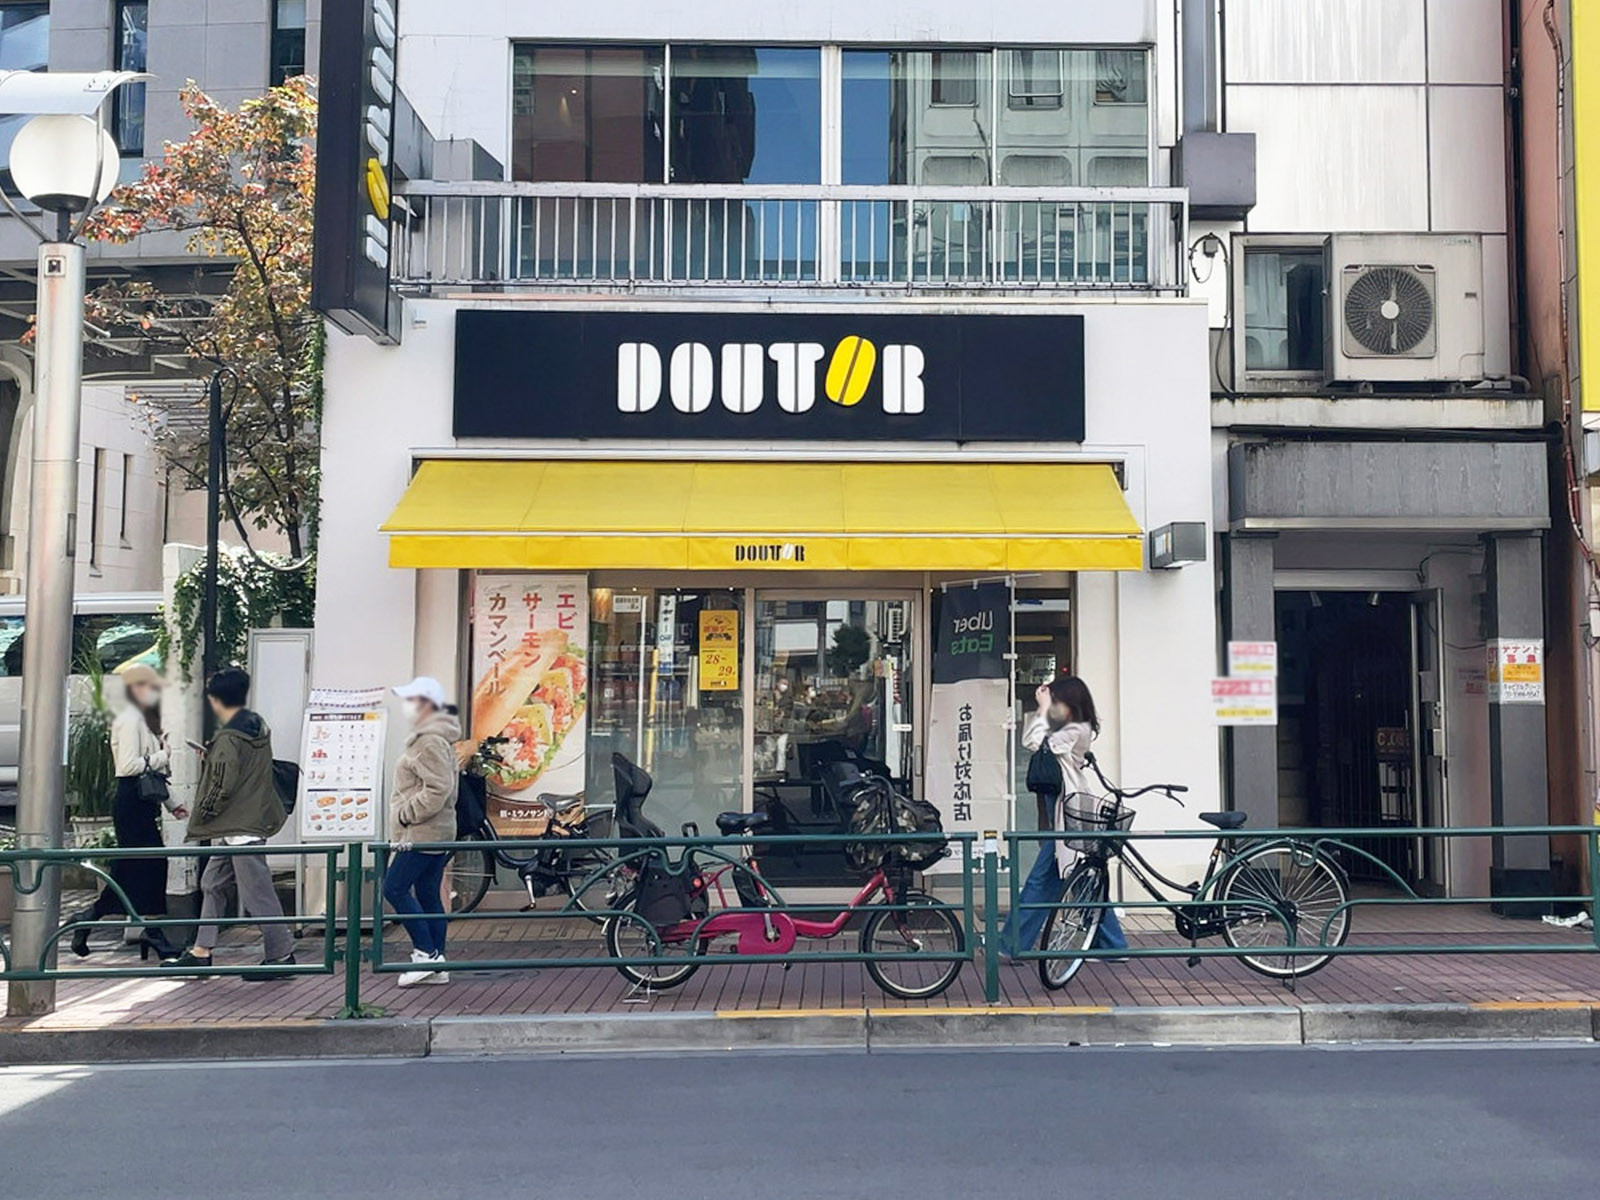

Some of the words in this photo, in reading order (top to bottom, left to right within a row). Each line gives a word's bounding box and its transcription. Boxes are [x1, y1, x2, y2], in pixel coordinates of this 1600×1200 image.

[617, 335, 926, 414] DOUTOR
[735, 543, 806, 562] DOUTOR
[522, 593, 543, 668] サーモン
[556, 593, 577, 629] エビ
[487, 593, 508, 694] カマンベール
[705, 654, 720, 665] 28
